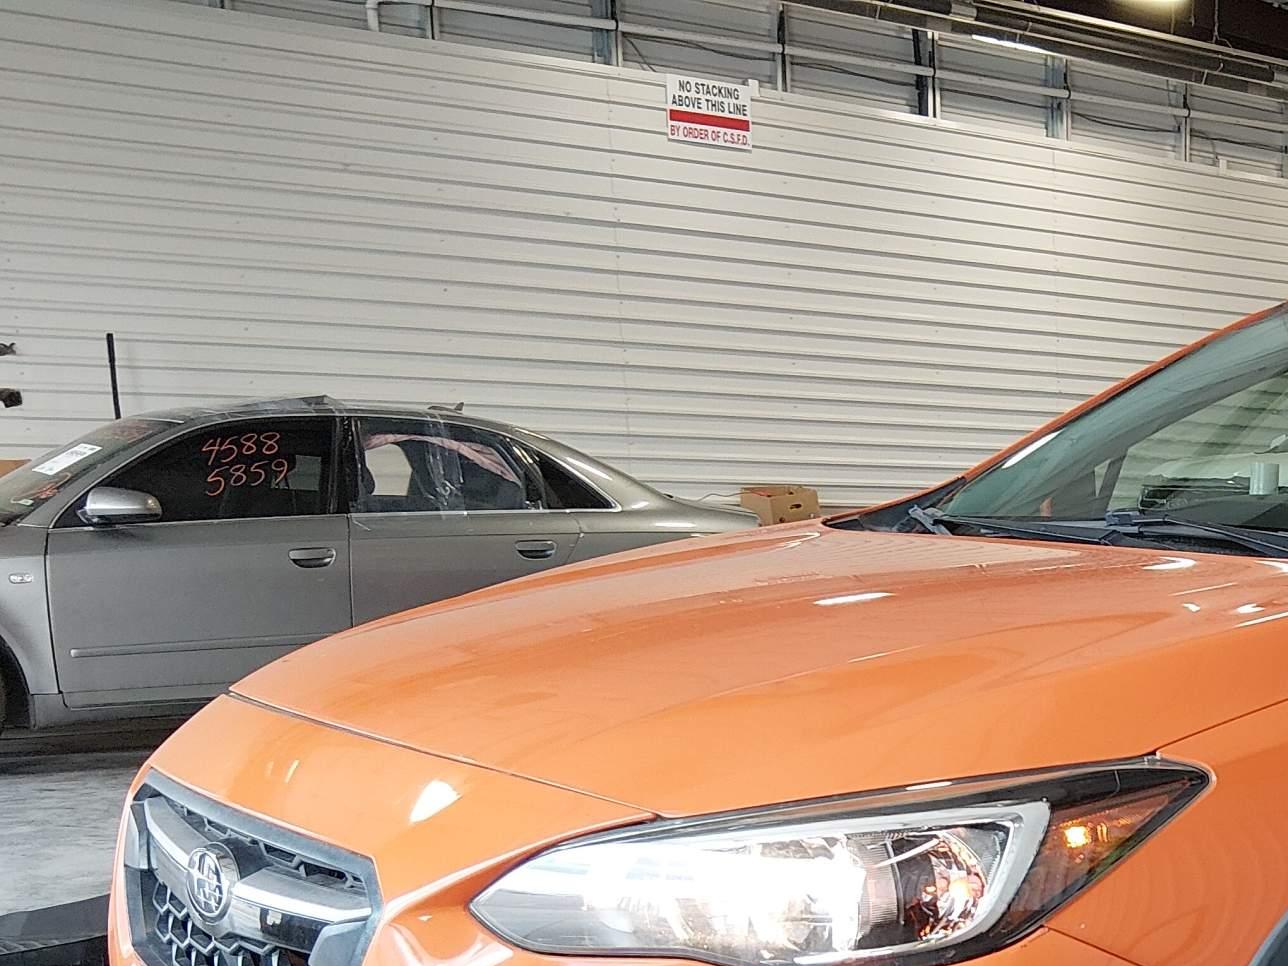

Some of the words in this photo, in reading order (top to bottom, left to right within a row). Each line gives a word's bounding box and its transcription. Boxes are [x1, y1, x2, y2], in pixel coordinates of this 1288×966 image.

[678, 80, 692, 93] NO
[694, 82, 740, 100] STACKING
[671, 94, 702, 109] ABOVE
[705, 98, 725, 113] THIS
[728, 102, 748, 116] LINE
[670, 124, 680, 137] BY
[682, 126, 709, 140] ORDER
[711, 129, 721, 142] OF
[723, 131, 750, 146] C.S.F.D.
[201, 431, 281, 466] 4588
[206, 458, 288, 497] 5859
